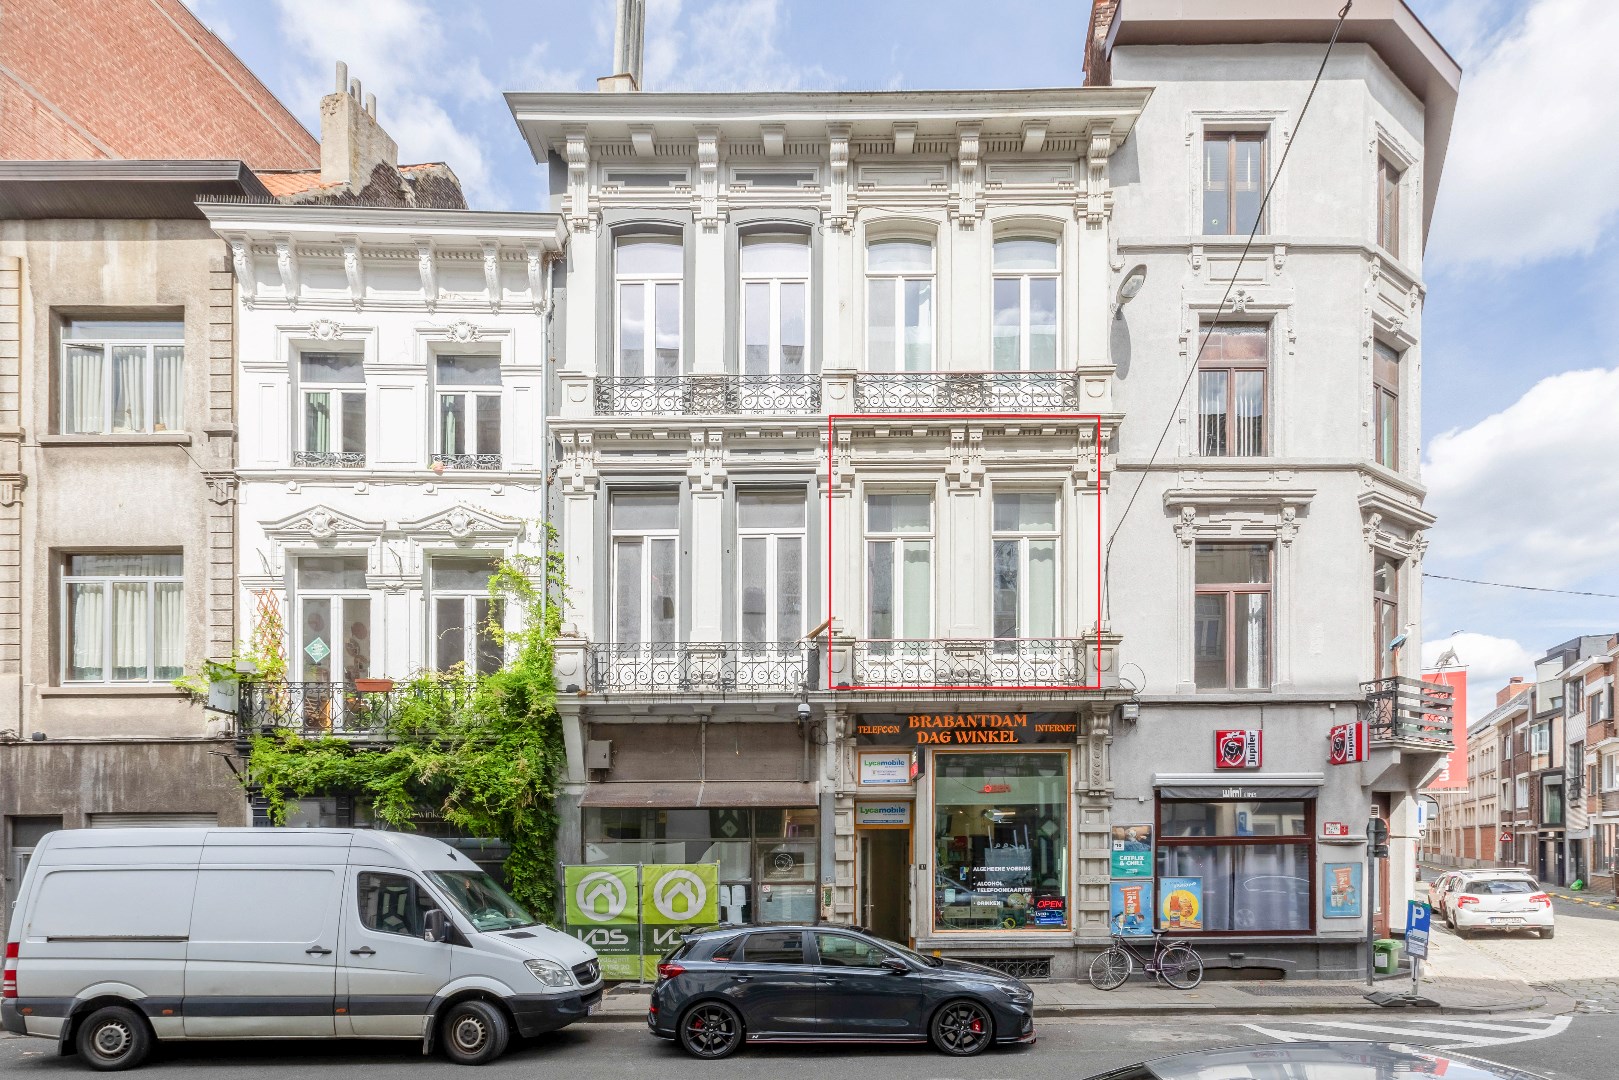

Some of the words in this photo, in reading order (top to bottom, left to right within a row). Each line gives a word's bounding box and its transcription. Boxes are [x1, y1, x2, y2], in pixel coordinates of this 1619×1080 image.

[908, 714, 1027, 728] BRABANTDAM
[1035, 724, 1077, 732] INTERNET
[917, 731, 952, 744] DAG
[955, 730, 1019, 743] WINKEL
[1248, 731, 1257, 765] Jupiler
[864, 759, 905, 767] Lycamobile
[860, 806, 906, 815] Lycamobile
[1037, 900, 1063, 908] OPEN
[1411, 904, 1425, 927] P
[577, 928, 629, 945] VDS
